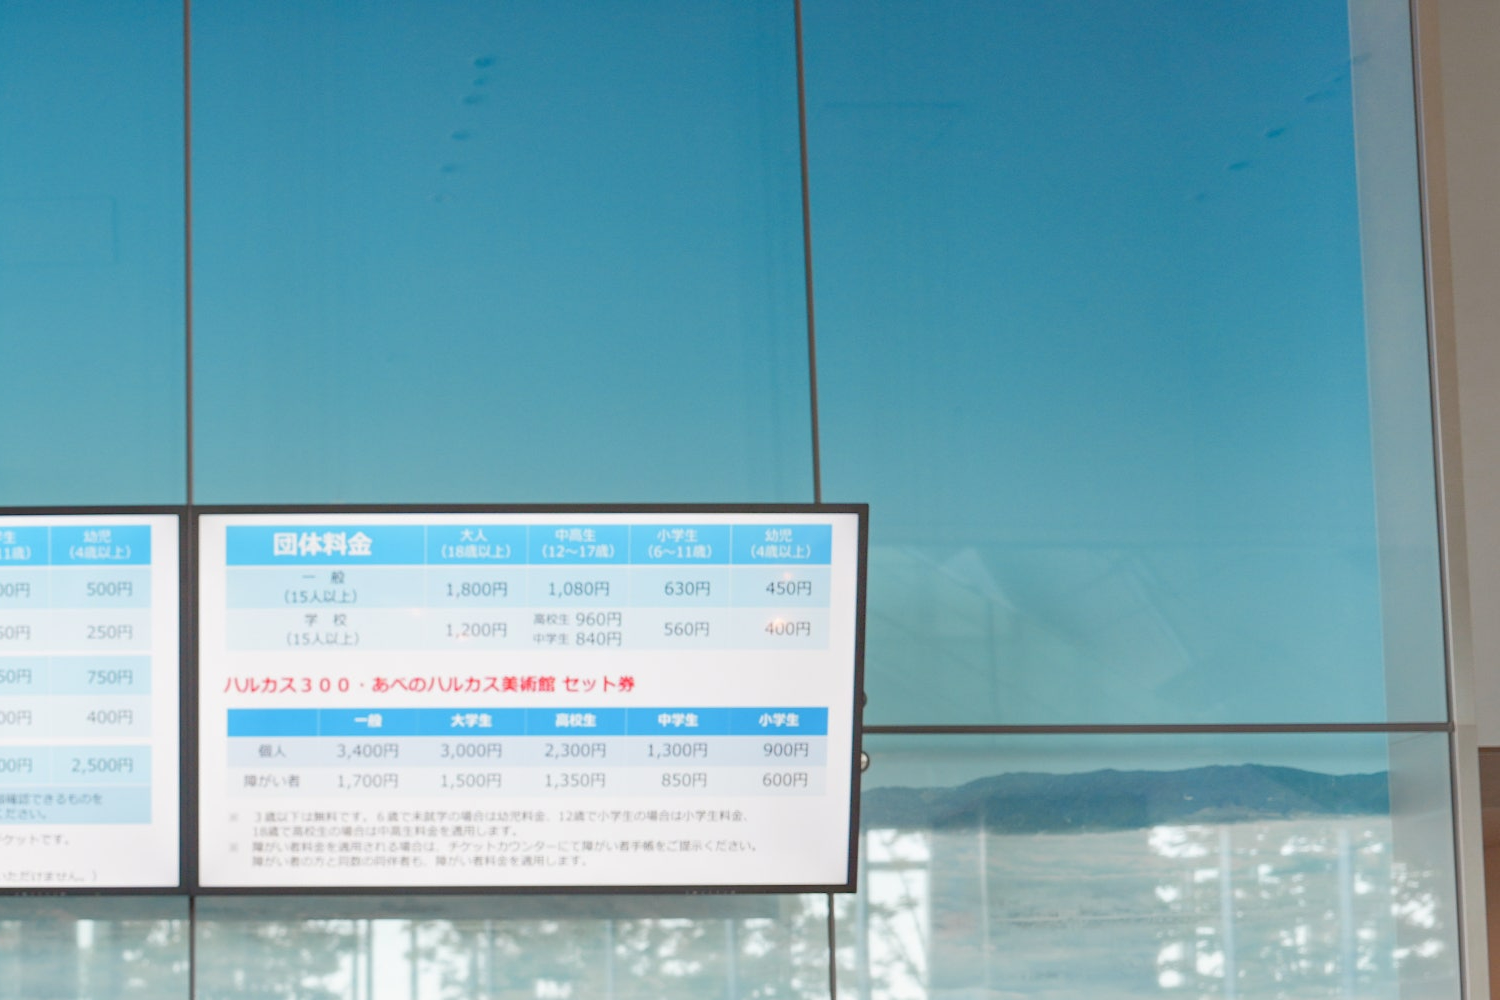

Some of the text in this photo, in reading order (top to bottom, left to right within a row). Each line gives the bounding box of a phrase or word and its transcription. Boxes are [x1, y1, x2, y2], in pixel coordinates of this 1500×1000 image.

[459, 529, 487, 542] 大人
[555, 529, 596, 543] 中高生
[657, 529, 698, 543] 小学生
[765, 529, 792, 542] 幼児
[273, 532, 372, 557] 団体料金
[87, 582, 133, 597] 500円
[446, 582, 508, 599] 1,800円
[549, 581, 610, 598] 1,080円
[665, 581, 711, 596] 630円
[766, 581, 812, 596] 450円
[533, 612, 622, 627] 高校生 960円
[87, 624, 133, 640] 250円
[446, 623, 508, 640] 1,200円
[664, 621, 710, 637] 560円
[764, 621, 811, 636] 400円
[533, 632, 622, 647] 中学生 840円
[87, 668, 133, 684] 750円
[563, 675, 635, 694] セット券
[87, 709, 133, 725] 400円
[354, 714, 383, 729] 一般
[451, 714, 492, 728] 大学生
[555, 713, 597, 728] 高校生
[658, 713, 698, 728] 中学生
[759, 713, 799, 728] 小学生
[258, 744, 287, 759] 個人
[337, 742, 399, 761] 3,400円
[440, 742, 502, 761] 3,000円
[544, 742, 606, 761] 2,300円
[647, 742, 708, 760] 1,300円
[763, 742, 809, 758] 900円
[71, 757, 133, 774] 2,500円
[244, 773, 300, 788] 障がい者
[338, 773, 399, 791] 1,700円
[441, 772, 502, 791] 1,500円
[545, 772, 606, 790] 1,350円
[661, 772, 708, 788] 850円
[763, 772, 809, 788] 600円
